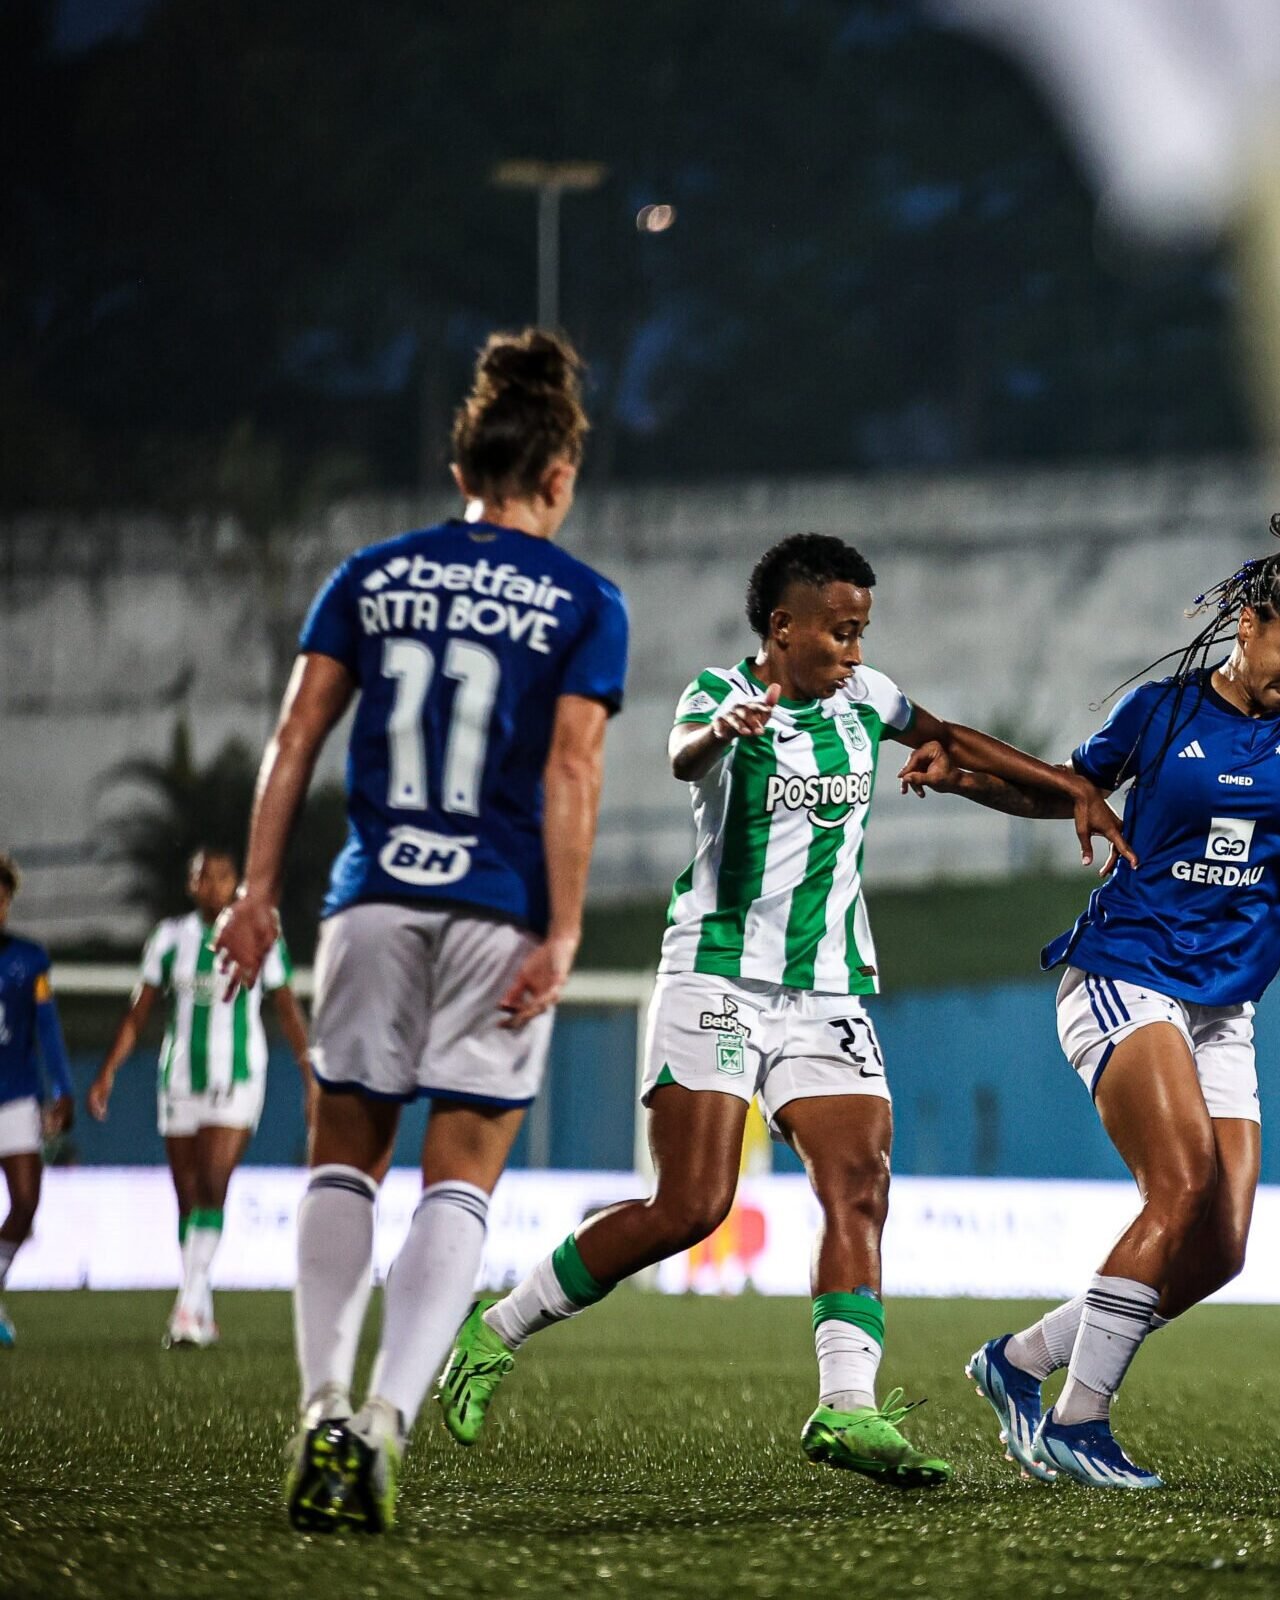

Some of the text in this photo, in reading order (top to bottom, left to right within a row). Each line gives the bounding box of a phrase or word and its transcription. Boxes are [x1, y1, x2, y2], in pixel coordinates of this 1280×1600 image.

[407, 553, 572, 611] betfair
[358, 590, 559, 655] RITA BOVE
[381, 635, 502, 818] 11
[766, 772, 871, 812] POSTOBO
[1217, 773, 1254, 787] CIMED
[390, 841, 458, 874] BH
[1171, 860, 1265, 887] GERDAU
